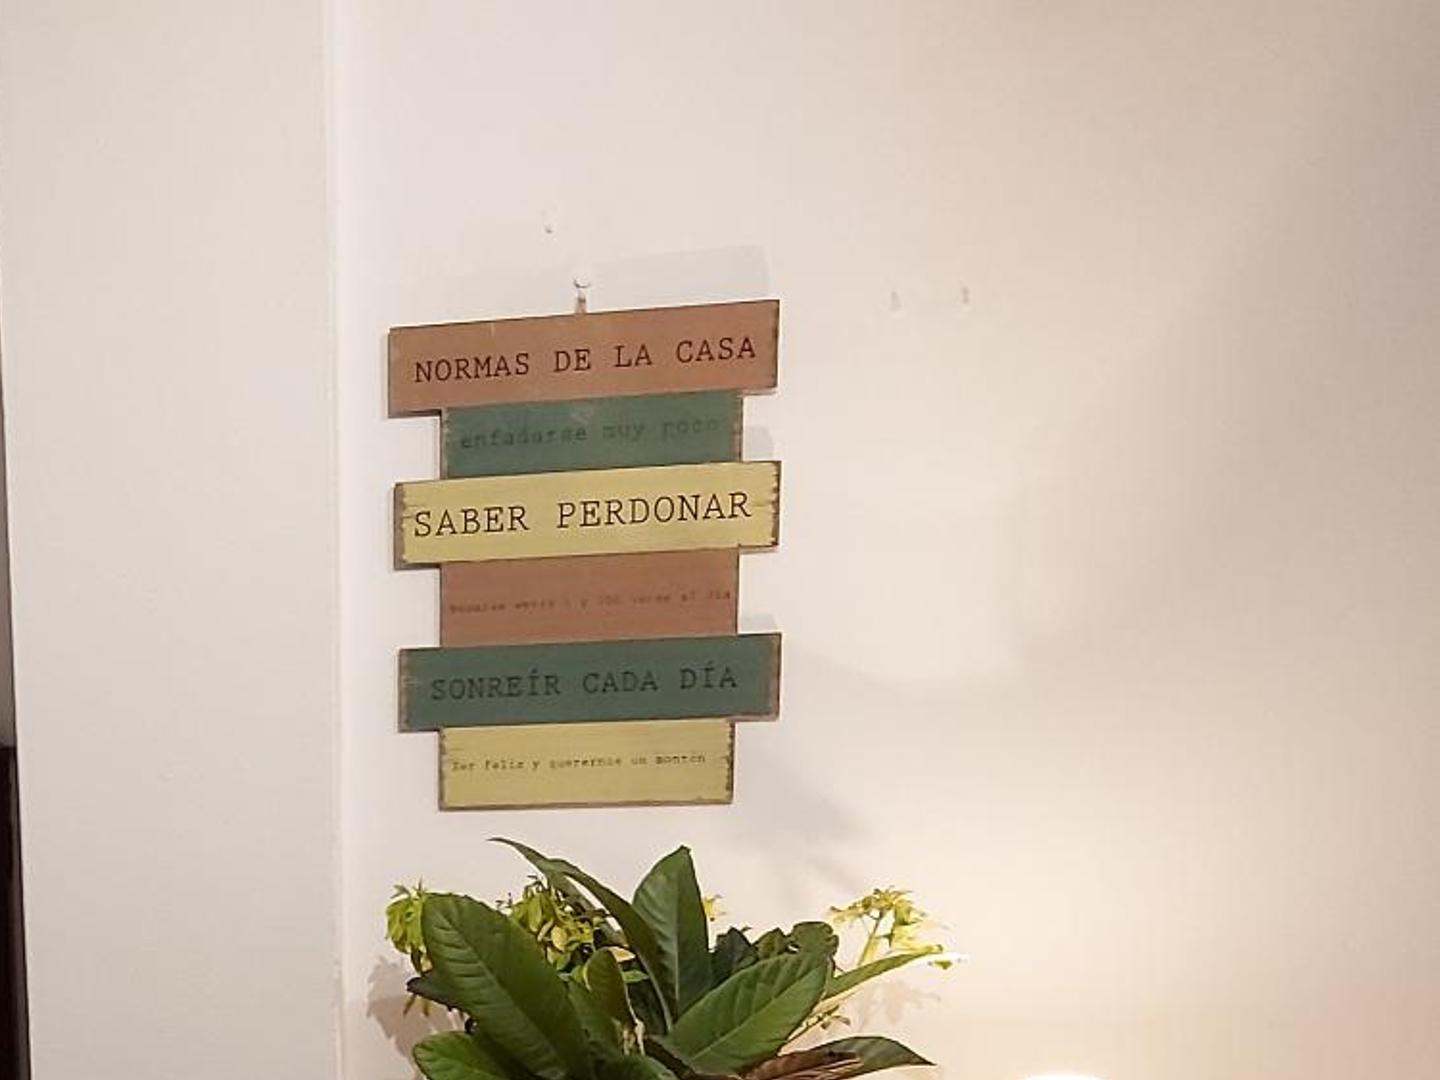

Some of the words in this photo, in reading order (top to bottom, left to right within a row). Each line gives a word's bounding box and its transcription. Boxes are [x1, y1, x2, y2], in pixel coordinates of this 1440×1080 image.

[415, 352, 530, 383] NORMAS
[553, 349, 592, 373] DE
[614, 344, 653, 369] LA
[677, 336, 757, 363] CASA
[414, 505, 530, 537] SABER
[557, 492, 753, 528] PERDONAR
[431, 666, 561, 700] SONREÍR
[582, 666, 659, 694] CADA
[679, 662, 738, 690] DÍA
